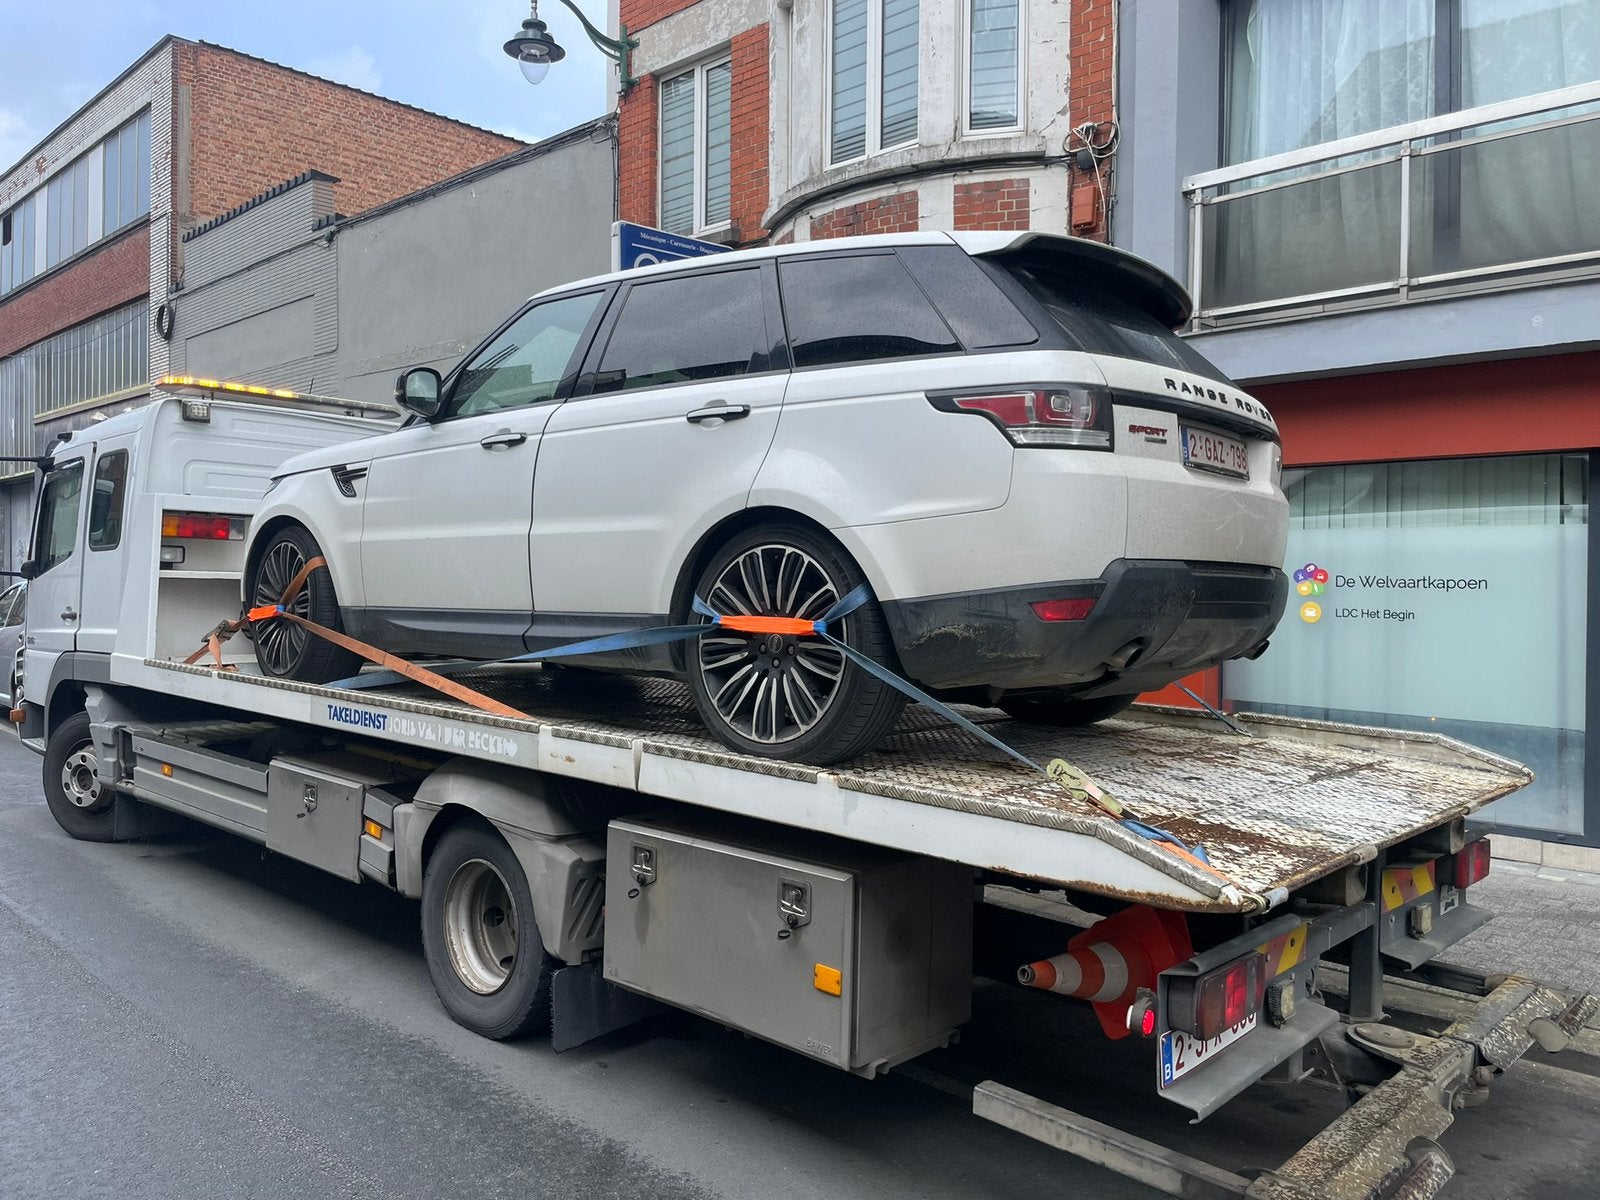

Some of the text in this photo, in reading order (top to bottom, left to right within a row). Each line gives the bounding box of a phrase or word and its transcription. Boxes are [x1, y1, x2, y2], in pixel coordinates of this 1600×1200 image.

[640, 232, 666, 244] Mécanique
[1164, 378, 1272, 422] RANGE ROVER
[1128, 424, 1168, 437] SPORT
[1335, 575, 1488, 592] De Welvaartkapoen
[1335, 608, 1415, 622] LDC Het Begin
[327, 704, 388, 731] TAKELDIENST
